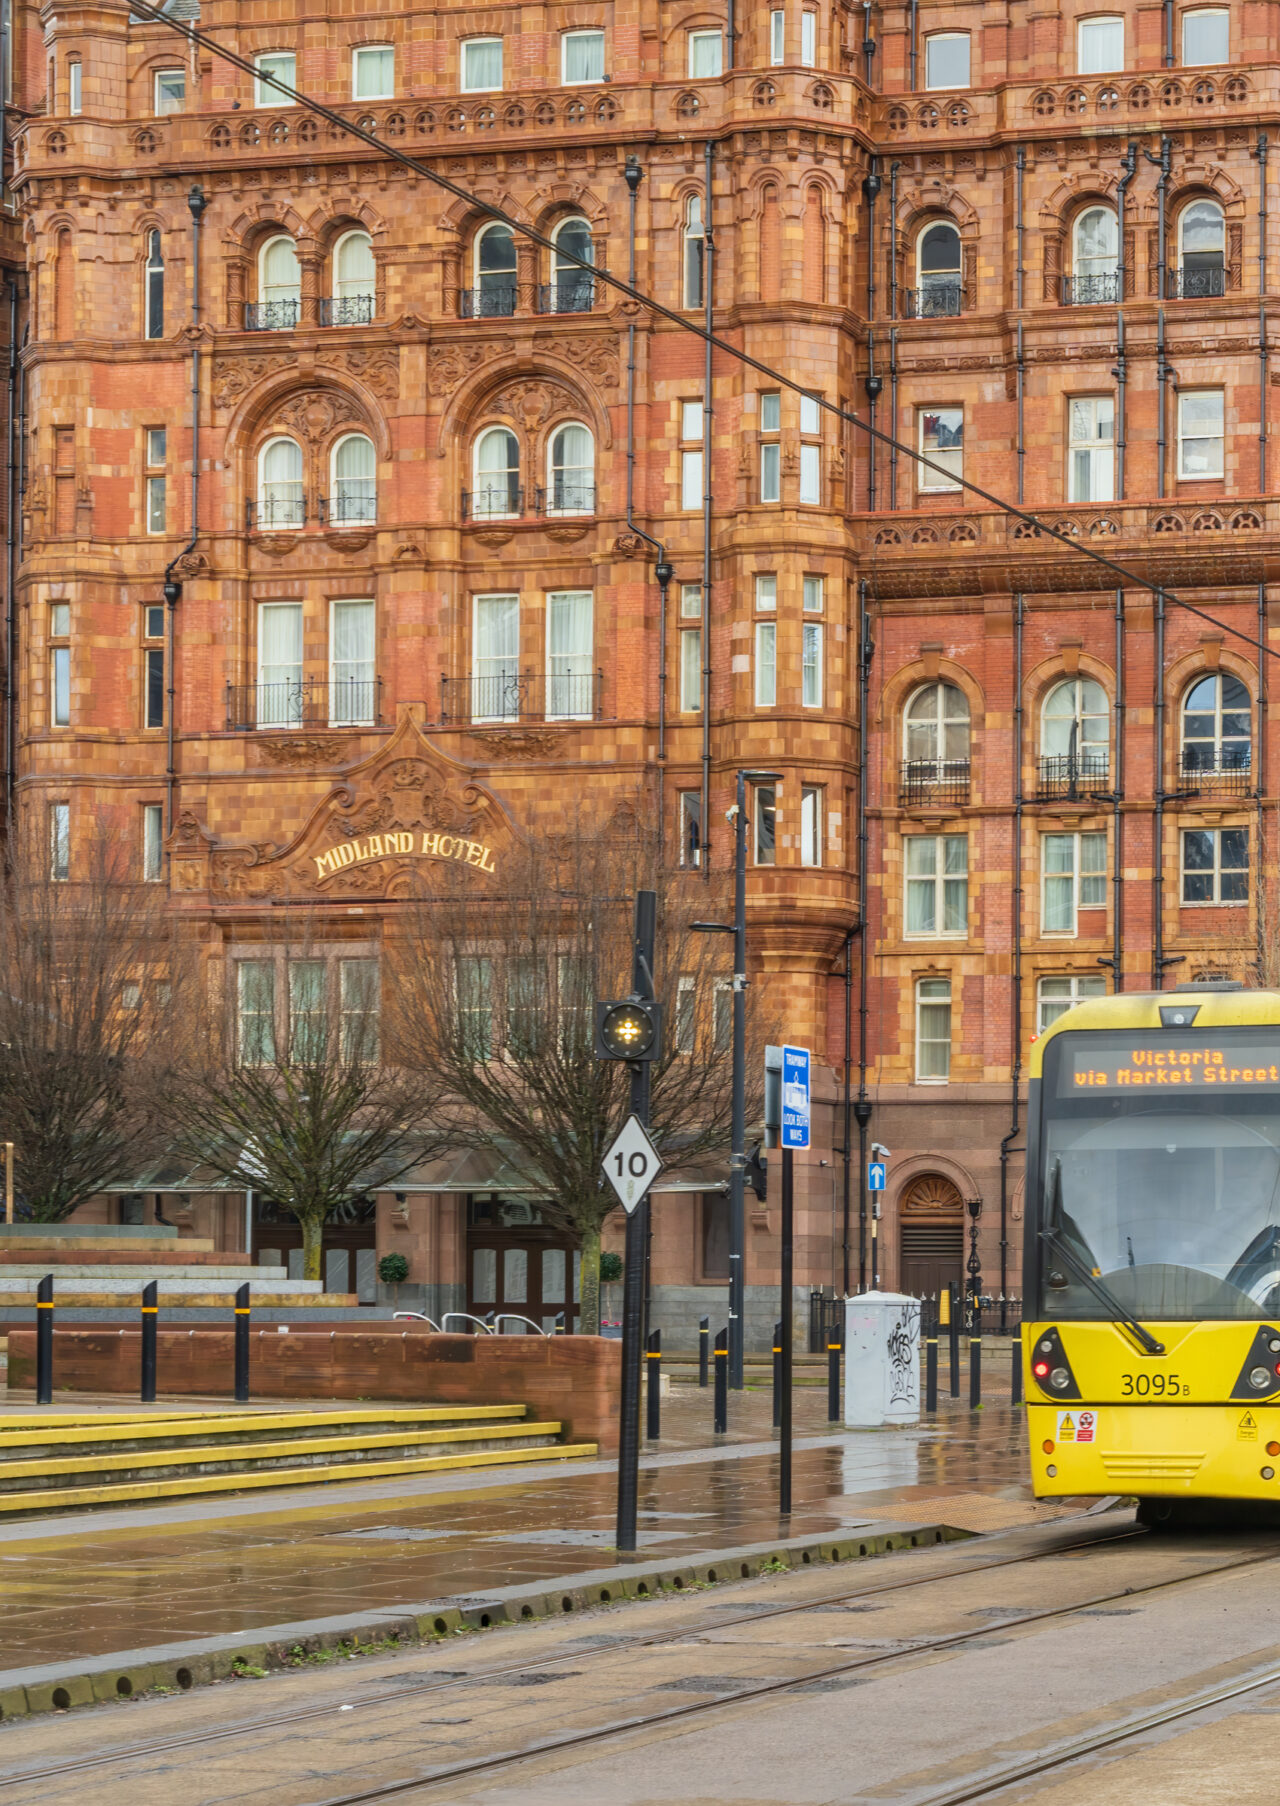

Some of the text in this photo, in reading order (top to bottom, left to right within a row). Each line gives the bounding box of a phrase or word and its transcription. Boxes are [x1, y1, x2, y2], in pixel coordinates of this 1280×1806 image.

[313, 831, 496, 880] MIDLAND HOTEL
[1131, 1048, 1225, 1067] Victoria
[1074, 1064, 1280, 1086] via Market Street
[613, 1151, 648, 1178] 10
